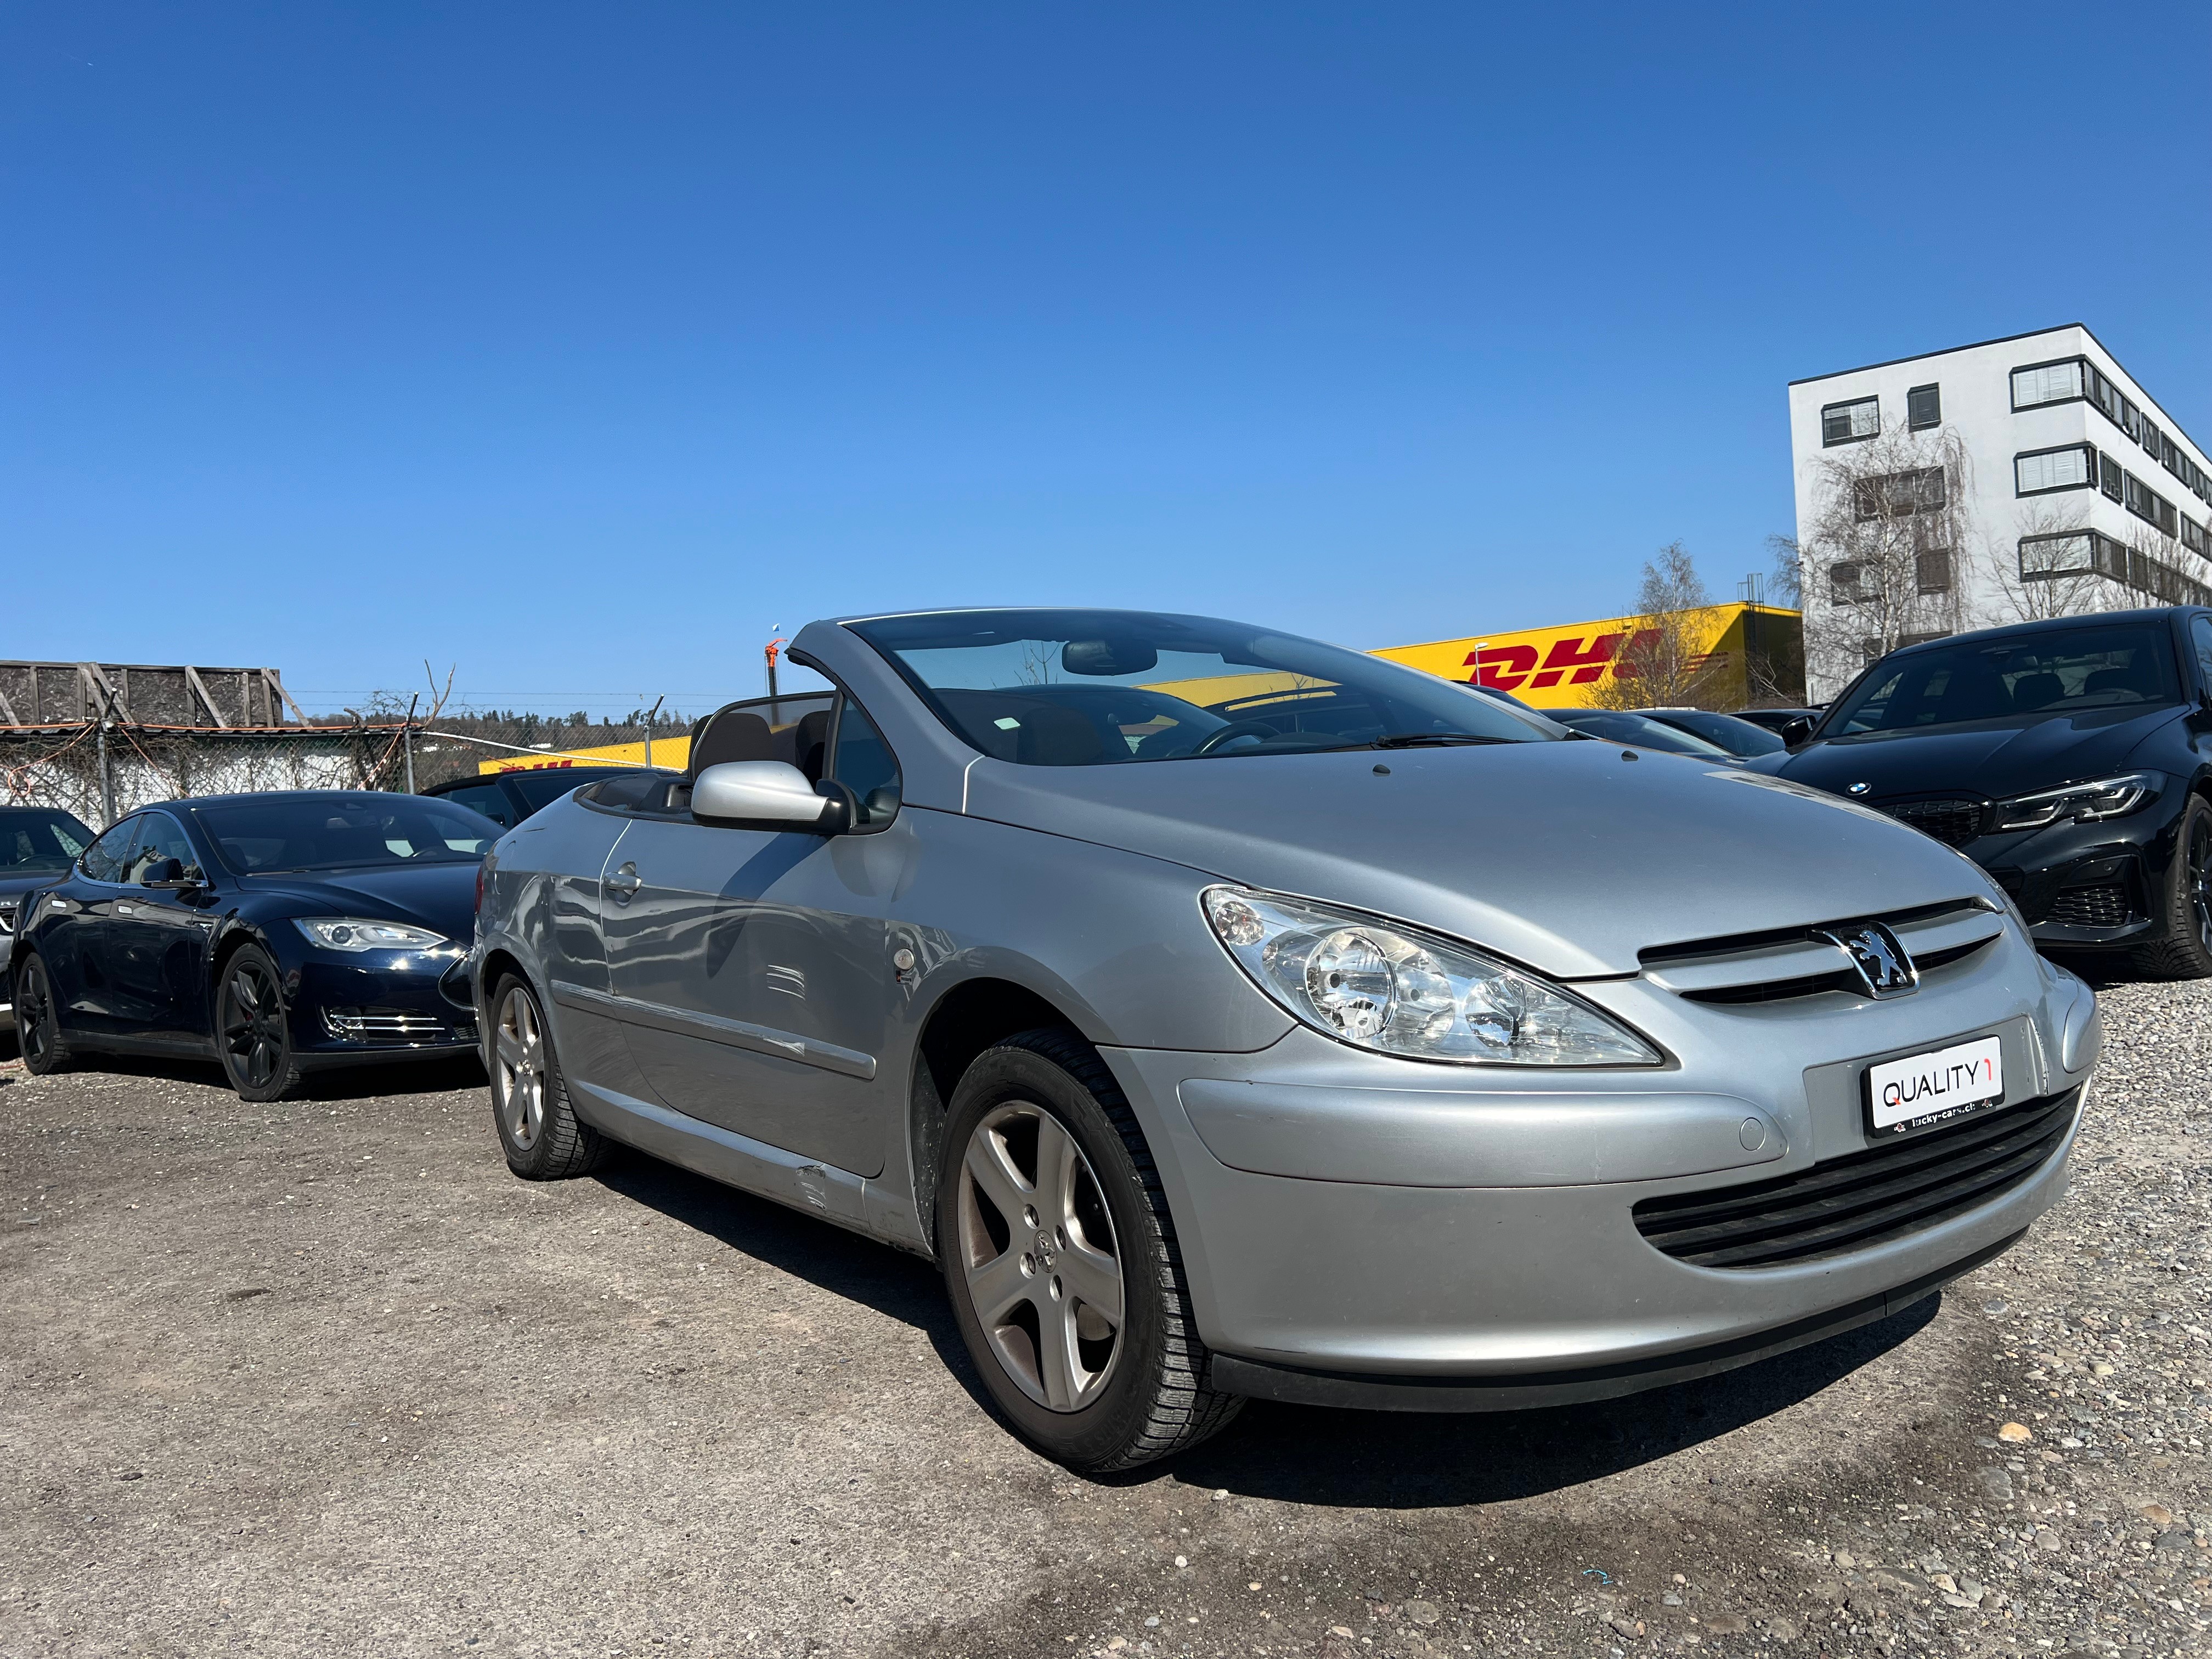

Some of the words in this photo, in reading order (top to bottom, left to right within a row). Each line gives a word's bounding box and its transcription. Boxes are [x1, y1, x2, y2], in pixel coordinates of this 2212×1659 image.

[1462, 629, 1681, 691] DHL
[1883, 1060, 1979, 1107] QUALITY
[1984, 1058, 1992, 1081] 1
